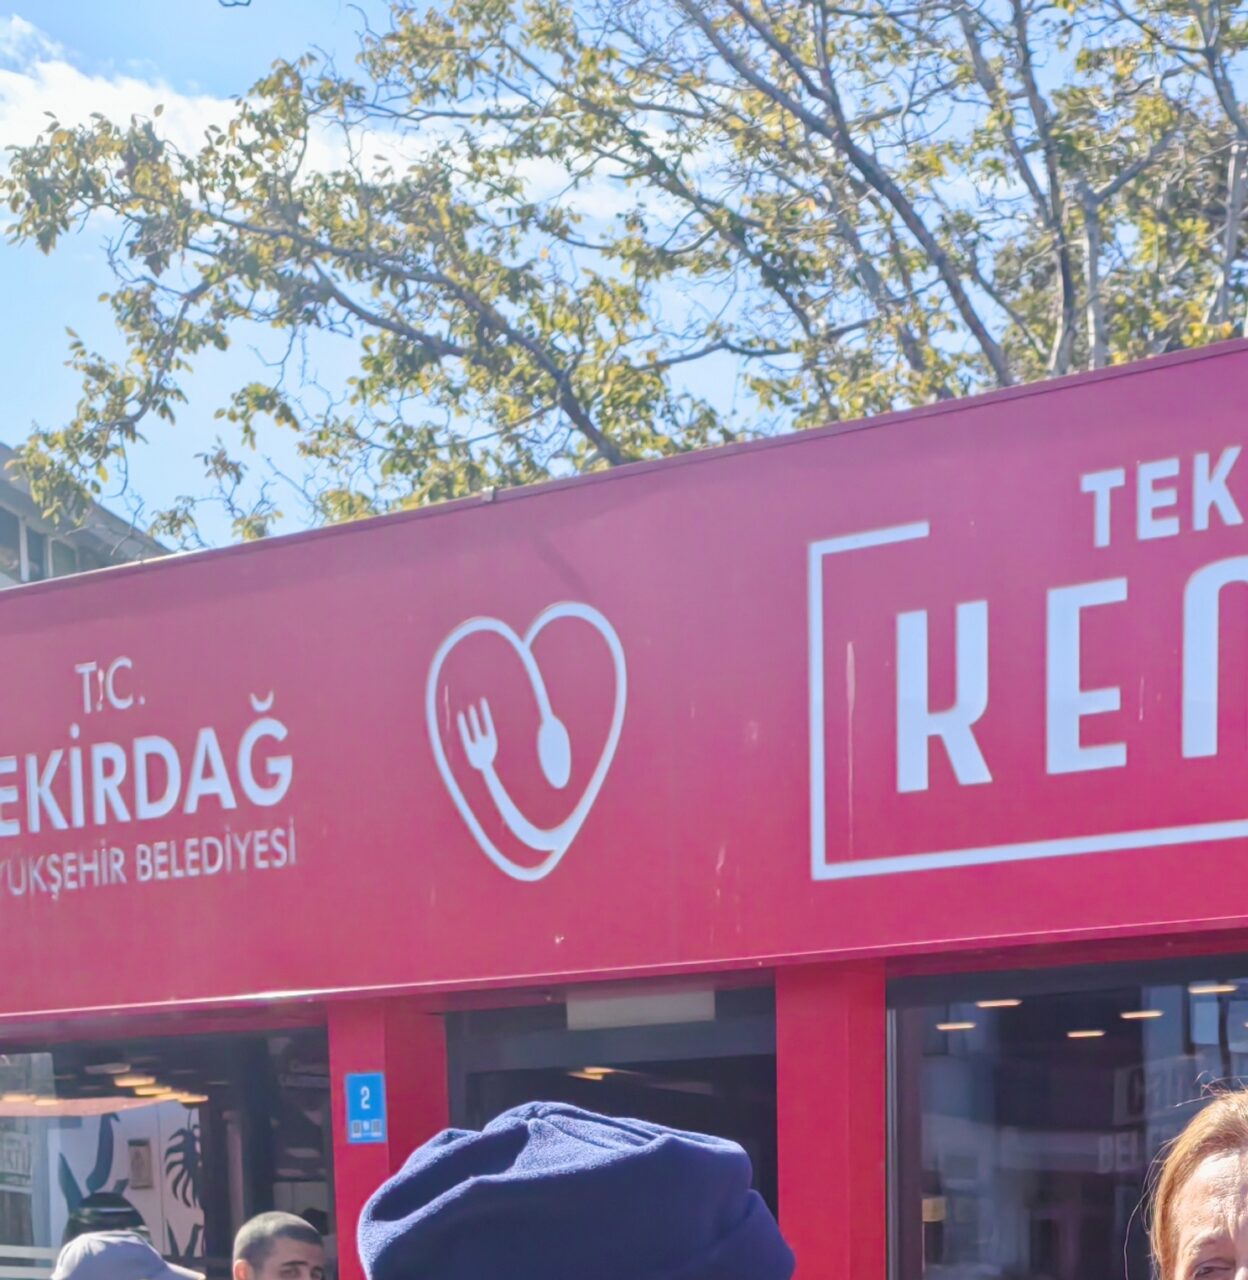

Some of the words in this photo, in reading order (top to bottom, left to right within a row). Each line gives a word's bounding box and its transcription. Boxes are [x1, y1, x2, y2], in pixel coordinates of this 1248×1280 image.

[75, 656, 146, 714] T.C.
[135, 816, 297, 882] BELEDİYESİ
[360, 1085, 371, 1110] 2
